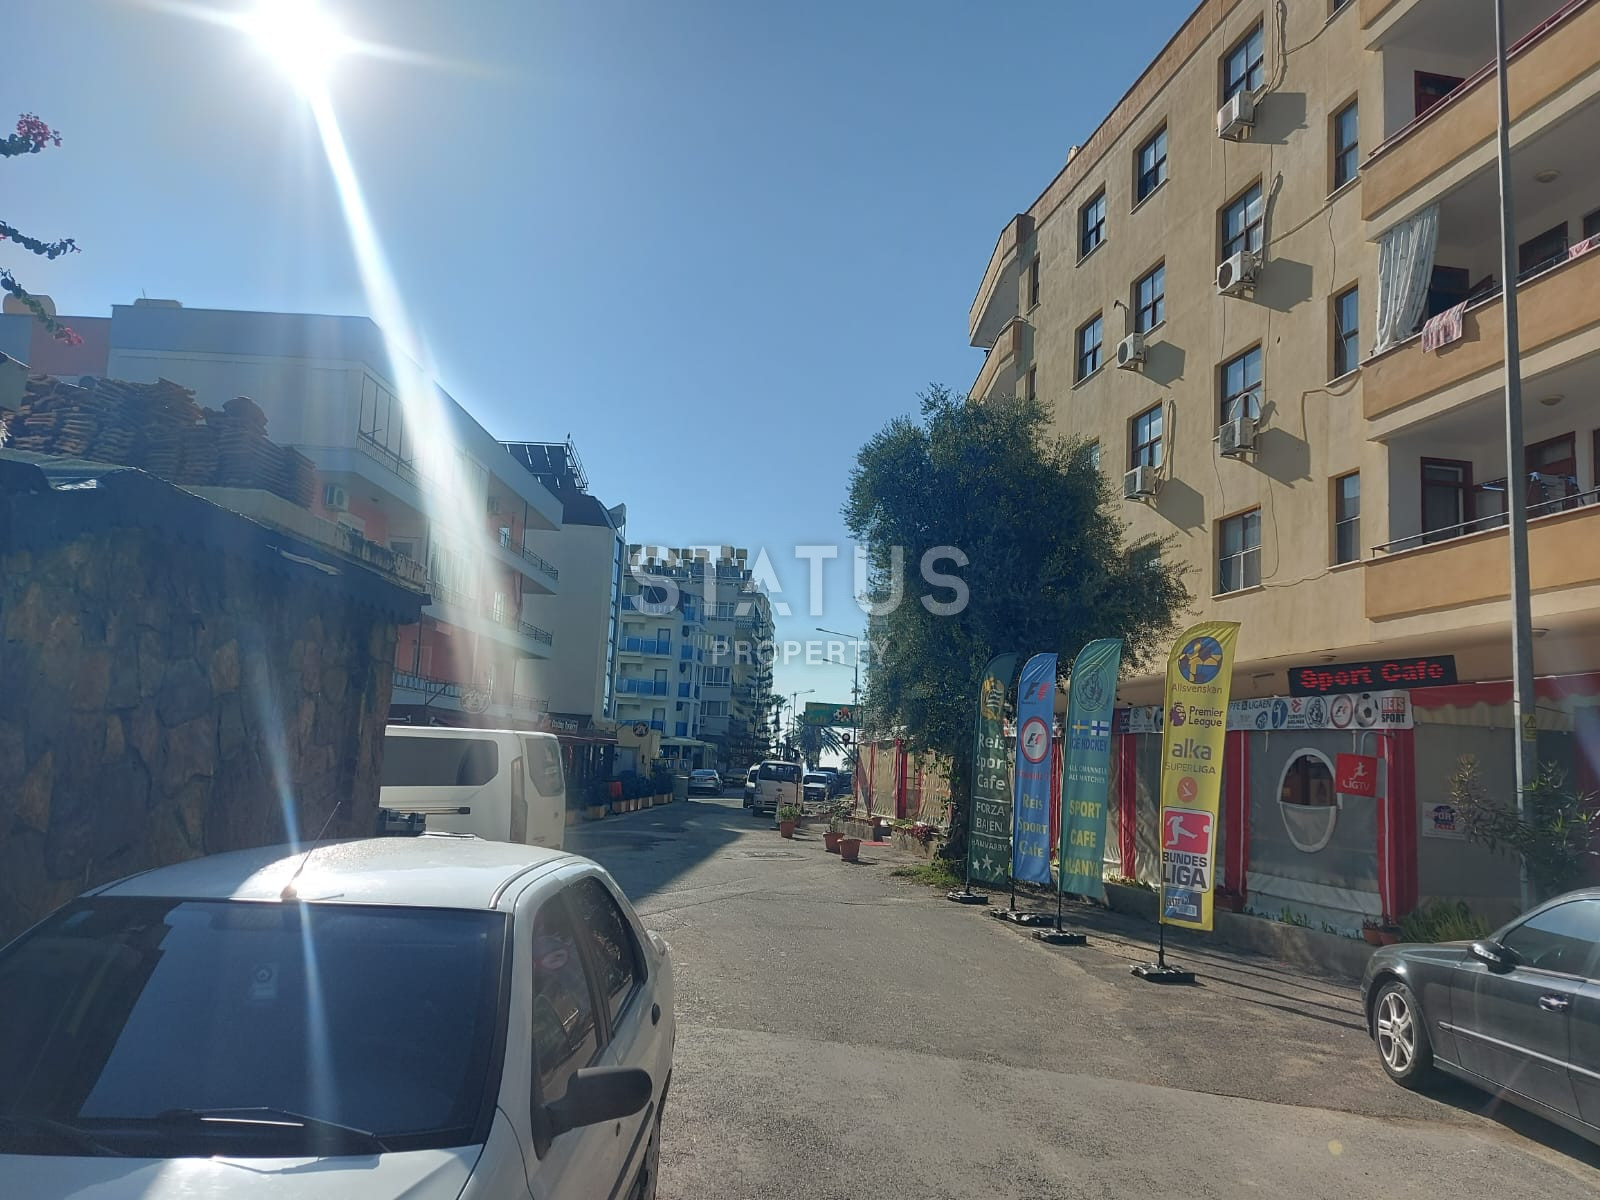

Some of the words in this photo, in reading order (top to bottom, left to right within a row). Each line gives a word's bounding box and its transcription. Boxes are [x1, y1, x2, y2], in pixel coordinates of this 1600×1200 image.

[1301, 666, 1374, 691] Sport
[1381, 661, 1445, 682] Cafe
[1172, 683, 1222, 694] Allsvenskan
[1189, 705, 1224, 717] Premier
[1382, 713, 1405, 723] SPORT
[1188, 716, 1222, 728] League
[979, 732, 1005, 749] Reis
[1165, 761, 1216, 775] SUPERLIGA
[977, 774, 1006, 791] Cafe
[976, 801, 1005, 816] FORZA
[1069, 799, 1102, 818] SPORT
[976, 817, 1003, 832] BAJEN
[1070, 829, 1097, 848] CAFE
[1163, 851, 1208, 867] BUNDES
[1064, 857, 1100, 878] ALANYA
[1163, 863, 1207, 889] LIGA
